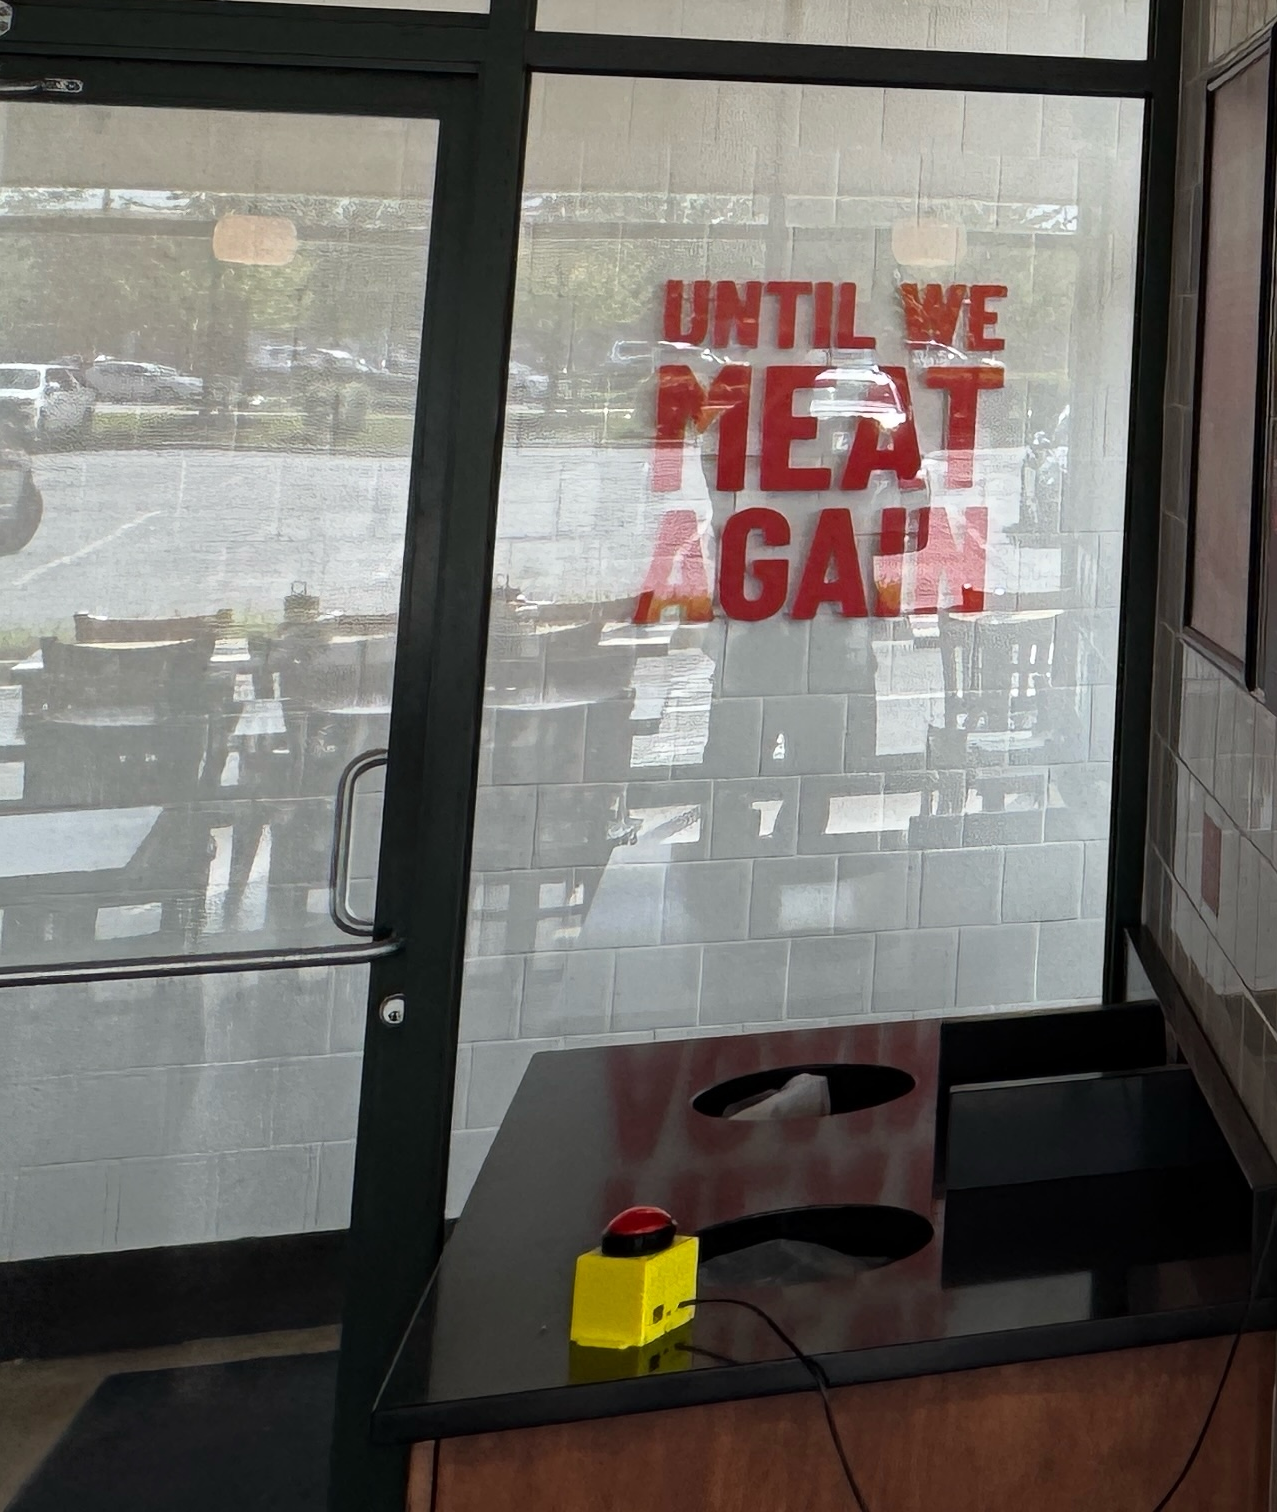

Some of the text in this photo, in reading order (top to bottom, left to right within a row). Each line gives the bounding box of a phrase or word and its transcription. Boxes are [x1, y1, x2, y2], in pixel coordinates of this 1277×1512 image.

[663, 280, 1008, 351] UNTIL WE
[651, 365, 1005, 492] MEAT
[632, 506, 988, 624] AGAIN
